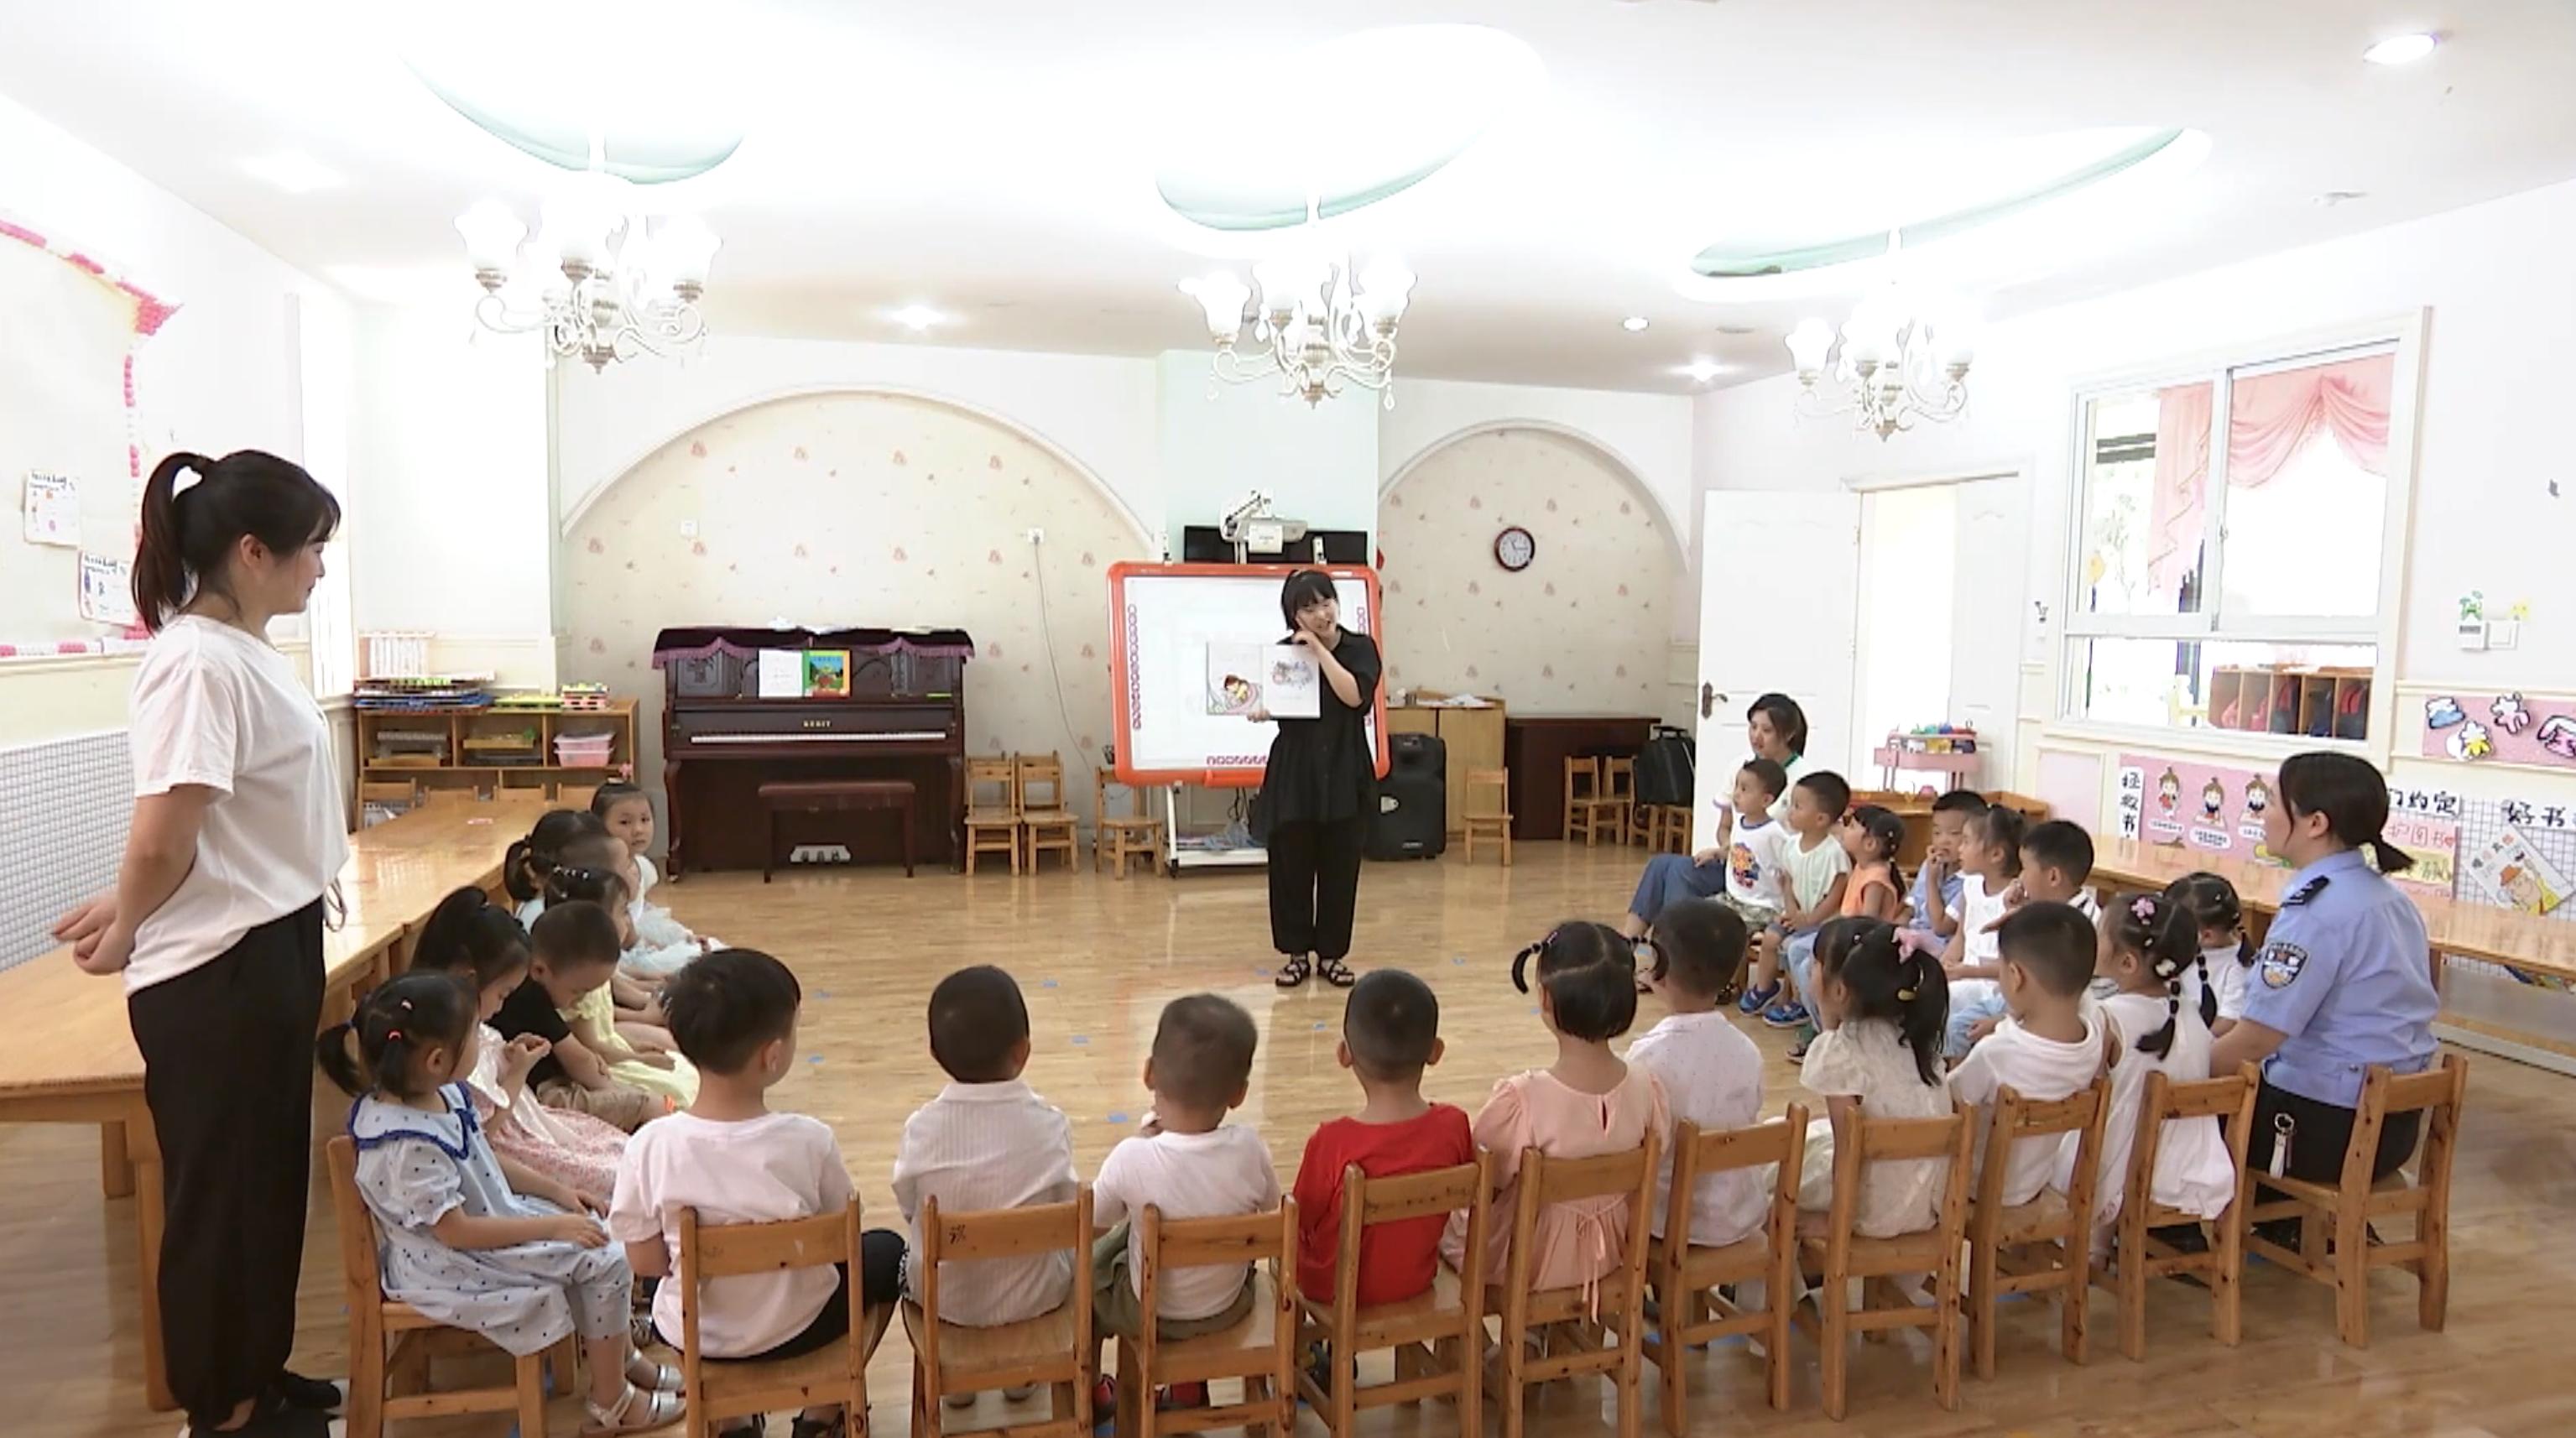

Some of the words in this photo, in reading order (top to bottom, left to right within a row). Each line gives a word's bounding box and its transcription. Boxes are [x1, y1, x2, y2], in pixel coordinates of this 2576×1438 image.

[2120, 771, 2141, 839] 拯救书
[2501, 801, 2576, 826] 好书
